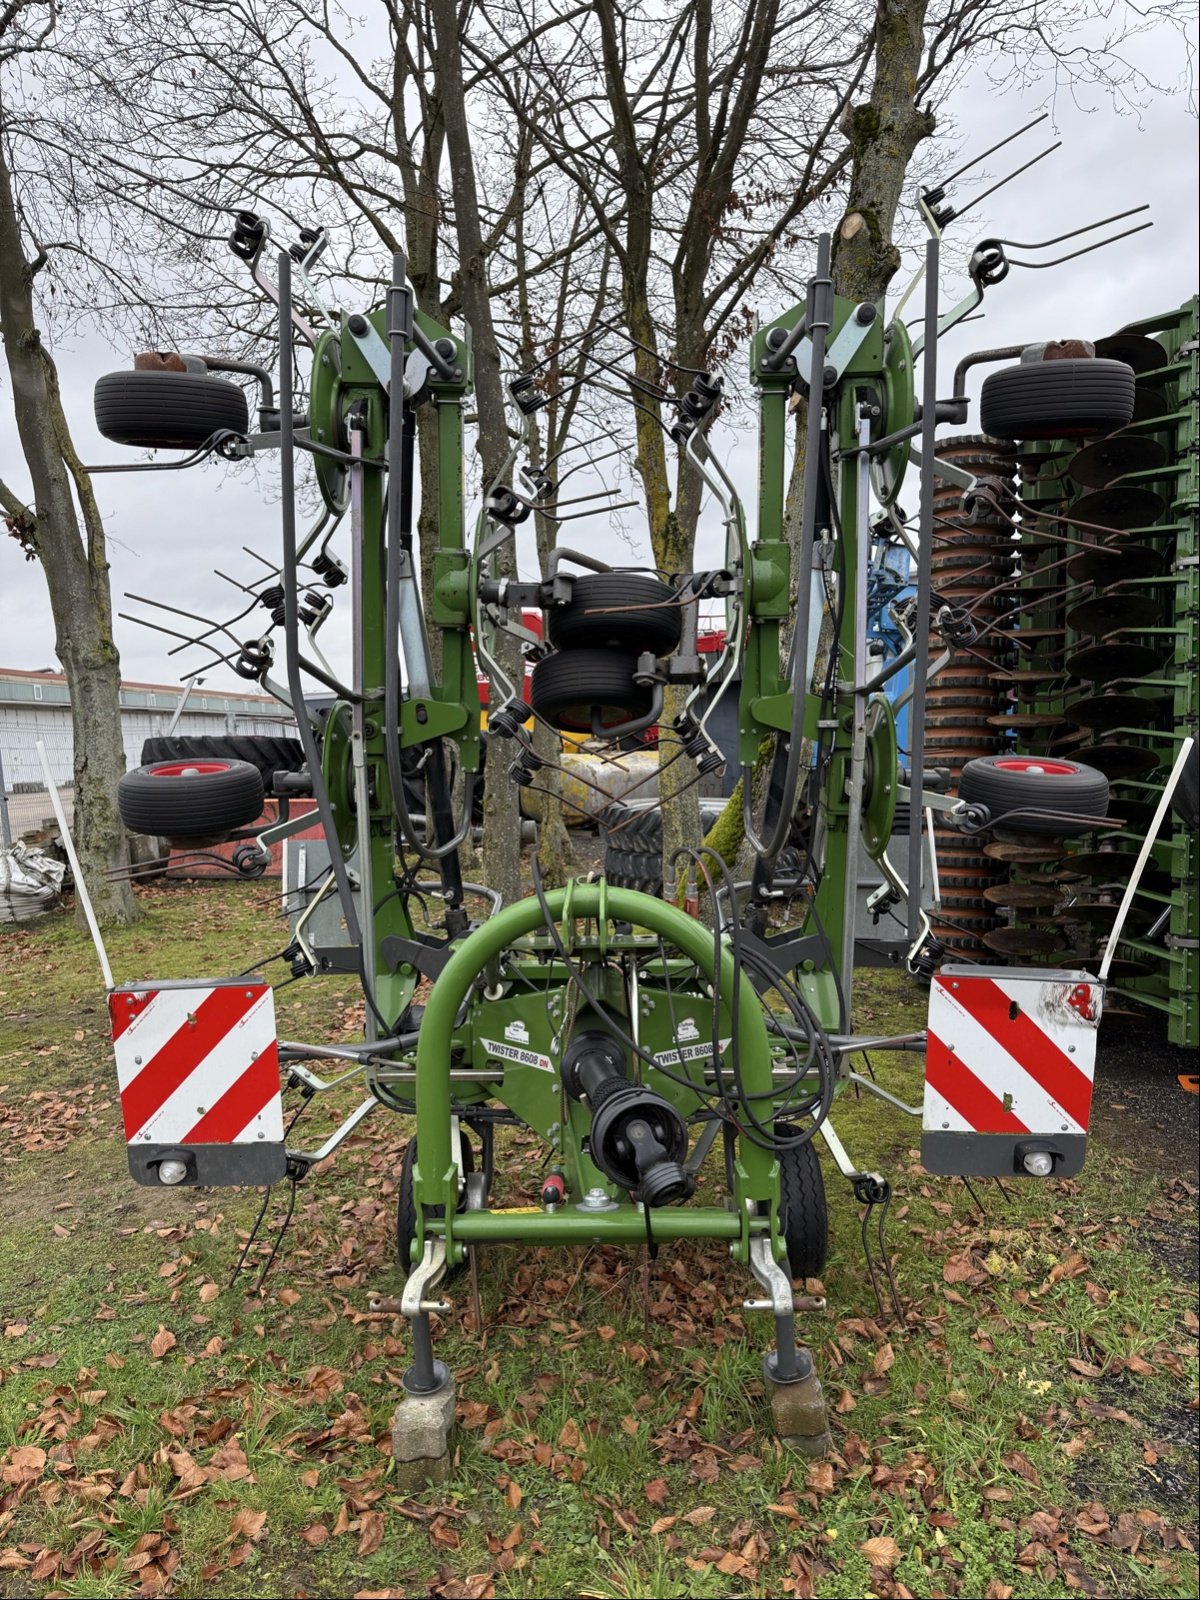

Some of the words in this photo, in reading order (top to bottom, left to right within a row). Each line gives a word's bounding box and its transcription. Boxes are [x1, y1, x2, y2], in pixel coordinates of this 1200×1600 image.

[488, 1042, 519, 1059] TWISTER
[520, 1051, 539, 1065] 8608
[539, 1059, 549, 1068] DN
[694, 1044, 713, 1056] 8608
